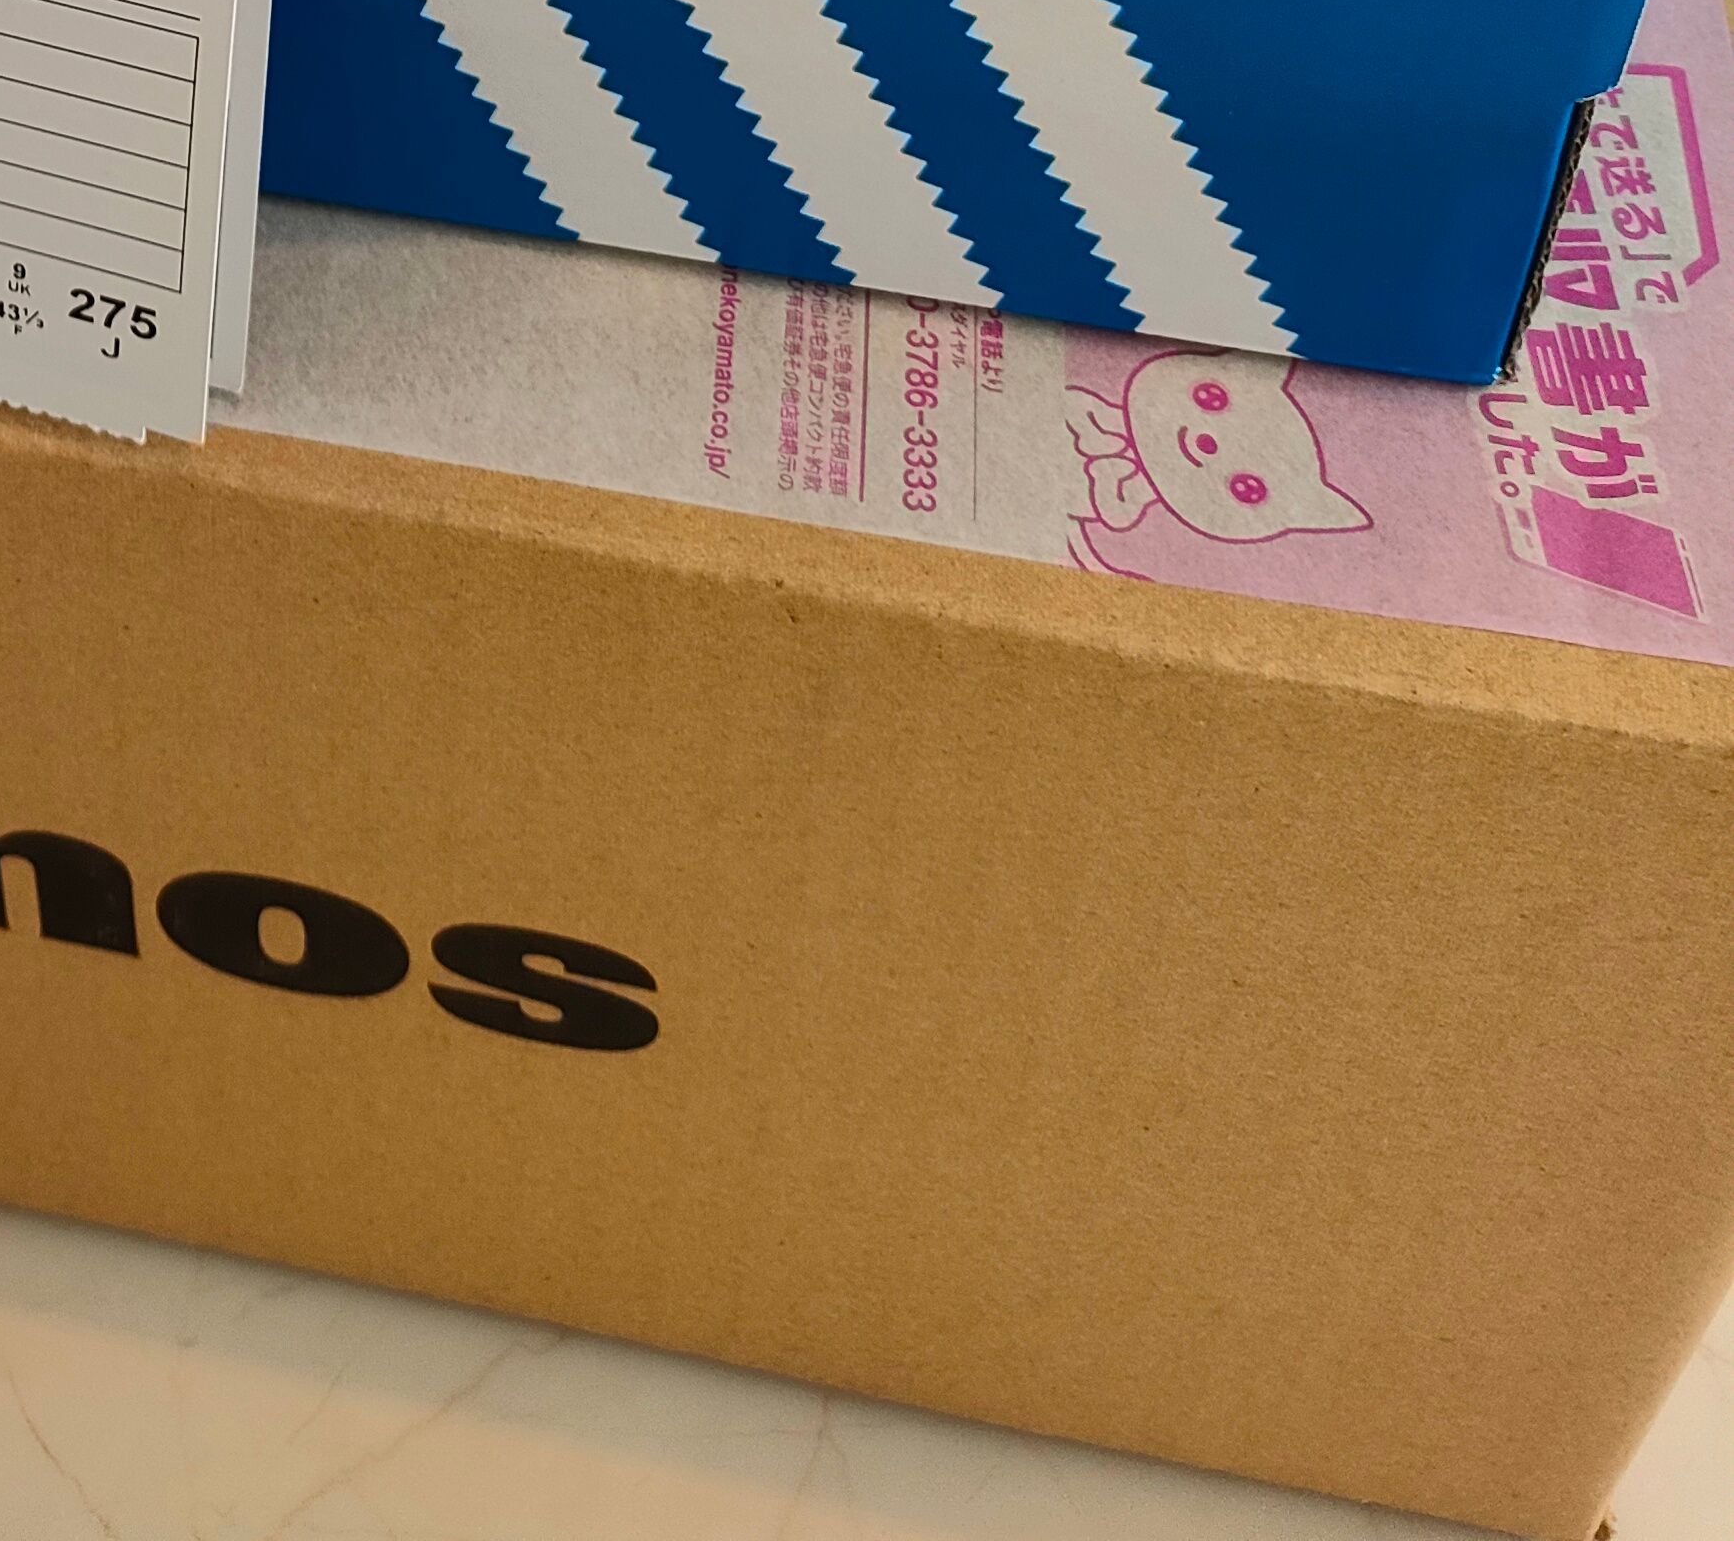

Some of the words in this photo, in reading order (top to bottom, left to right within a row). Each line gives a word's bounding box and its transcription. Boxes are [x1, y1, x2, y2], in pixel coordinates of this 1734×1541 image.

[1590, 87, 1680, 305] で送る」で
[8, 279, 31, 296] UK
[12, 263, 27, 280] 9
[68, 287, 158, 340] 275
[100, 337, 121, 359] J
[703, 264, 742, 479] nekoyamato.co.jp/
